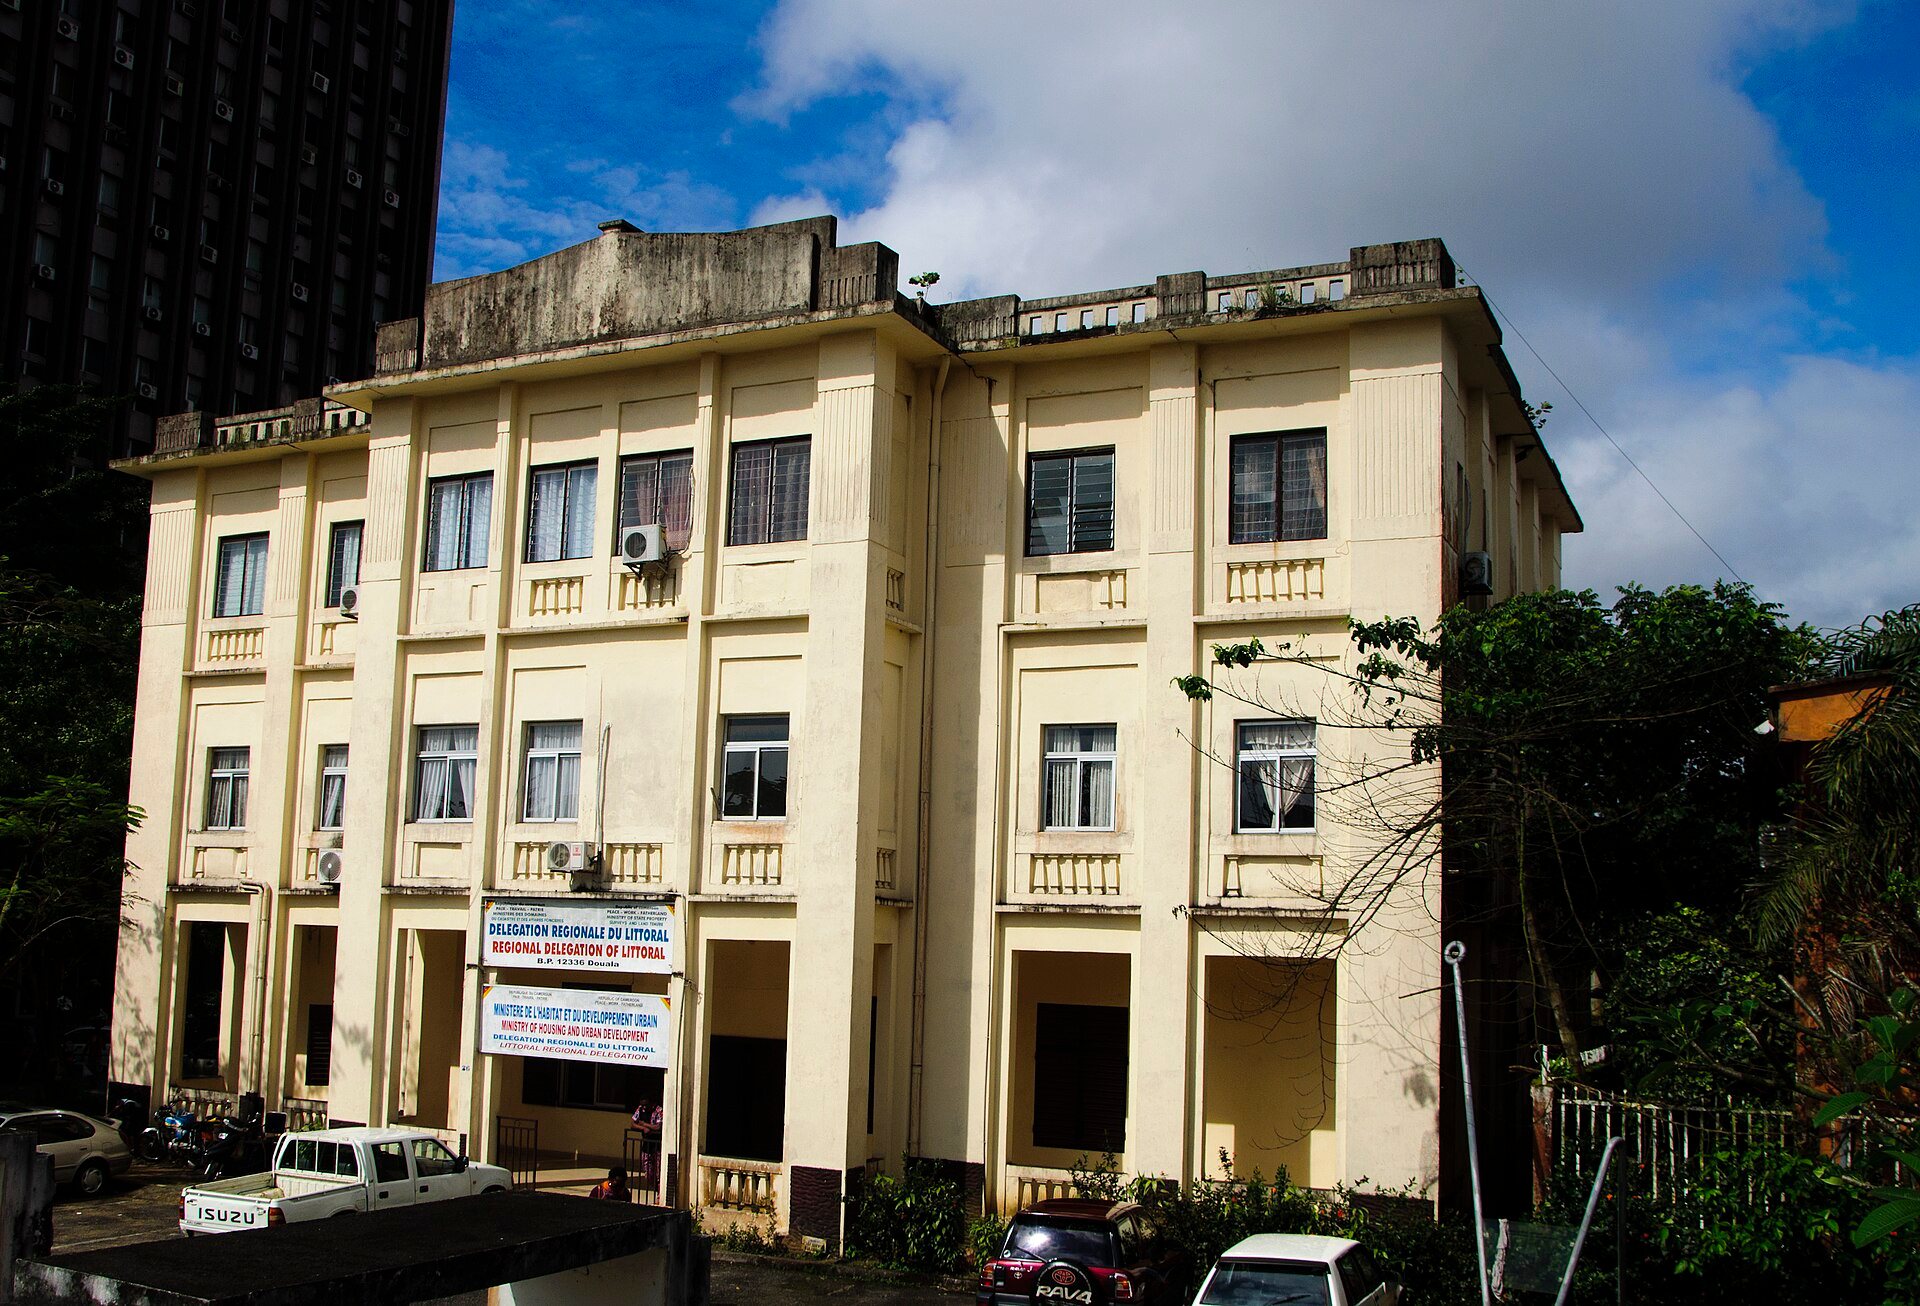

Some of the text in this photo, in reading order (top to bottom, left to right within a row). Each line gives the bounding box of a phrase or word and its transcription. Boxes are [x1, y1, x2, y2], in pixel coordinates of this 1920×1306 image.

[490, 923, 669, 942] DELEGATION REGIONALE DU LITTORAL
[492, 941, 665, 959] REGIONAL DELEGATION OF LITTORAL
[494, 1003, 657, 1028] MINISTERE DE L'HABITAT ET DU DEVELOPPEMENT URBAIN
[502, 1020, 648, 1042] MINISTRY OF HOUSING AND URBAN DEVELOPMENT
[493, 1034, 544, 1043] DELEGATION
[547, 1039, 595, 1048] REGIONALE
[613, 1044, 655, 1053] LITTORAL
[500, 1042, 648, 1060] LITTORAL REGIONAL DELEGATION
[198, 1207, 254, 1224] ISUZU
[1036, 1286, 1092, 1304] RAV4
